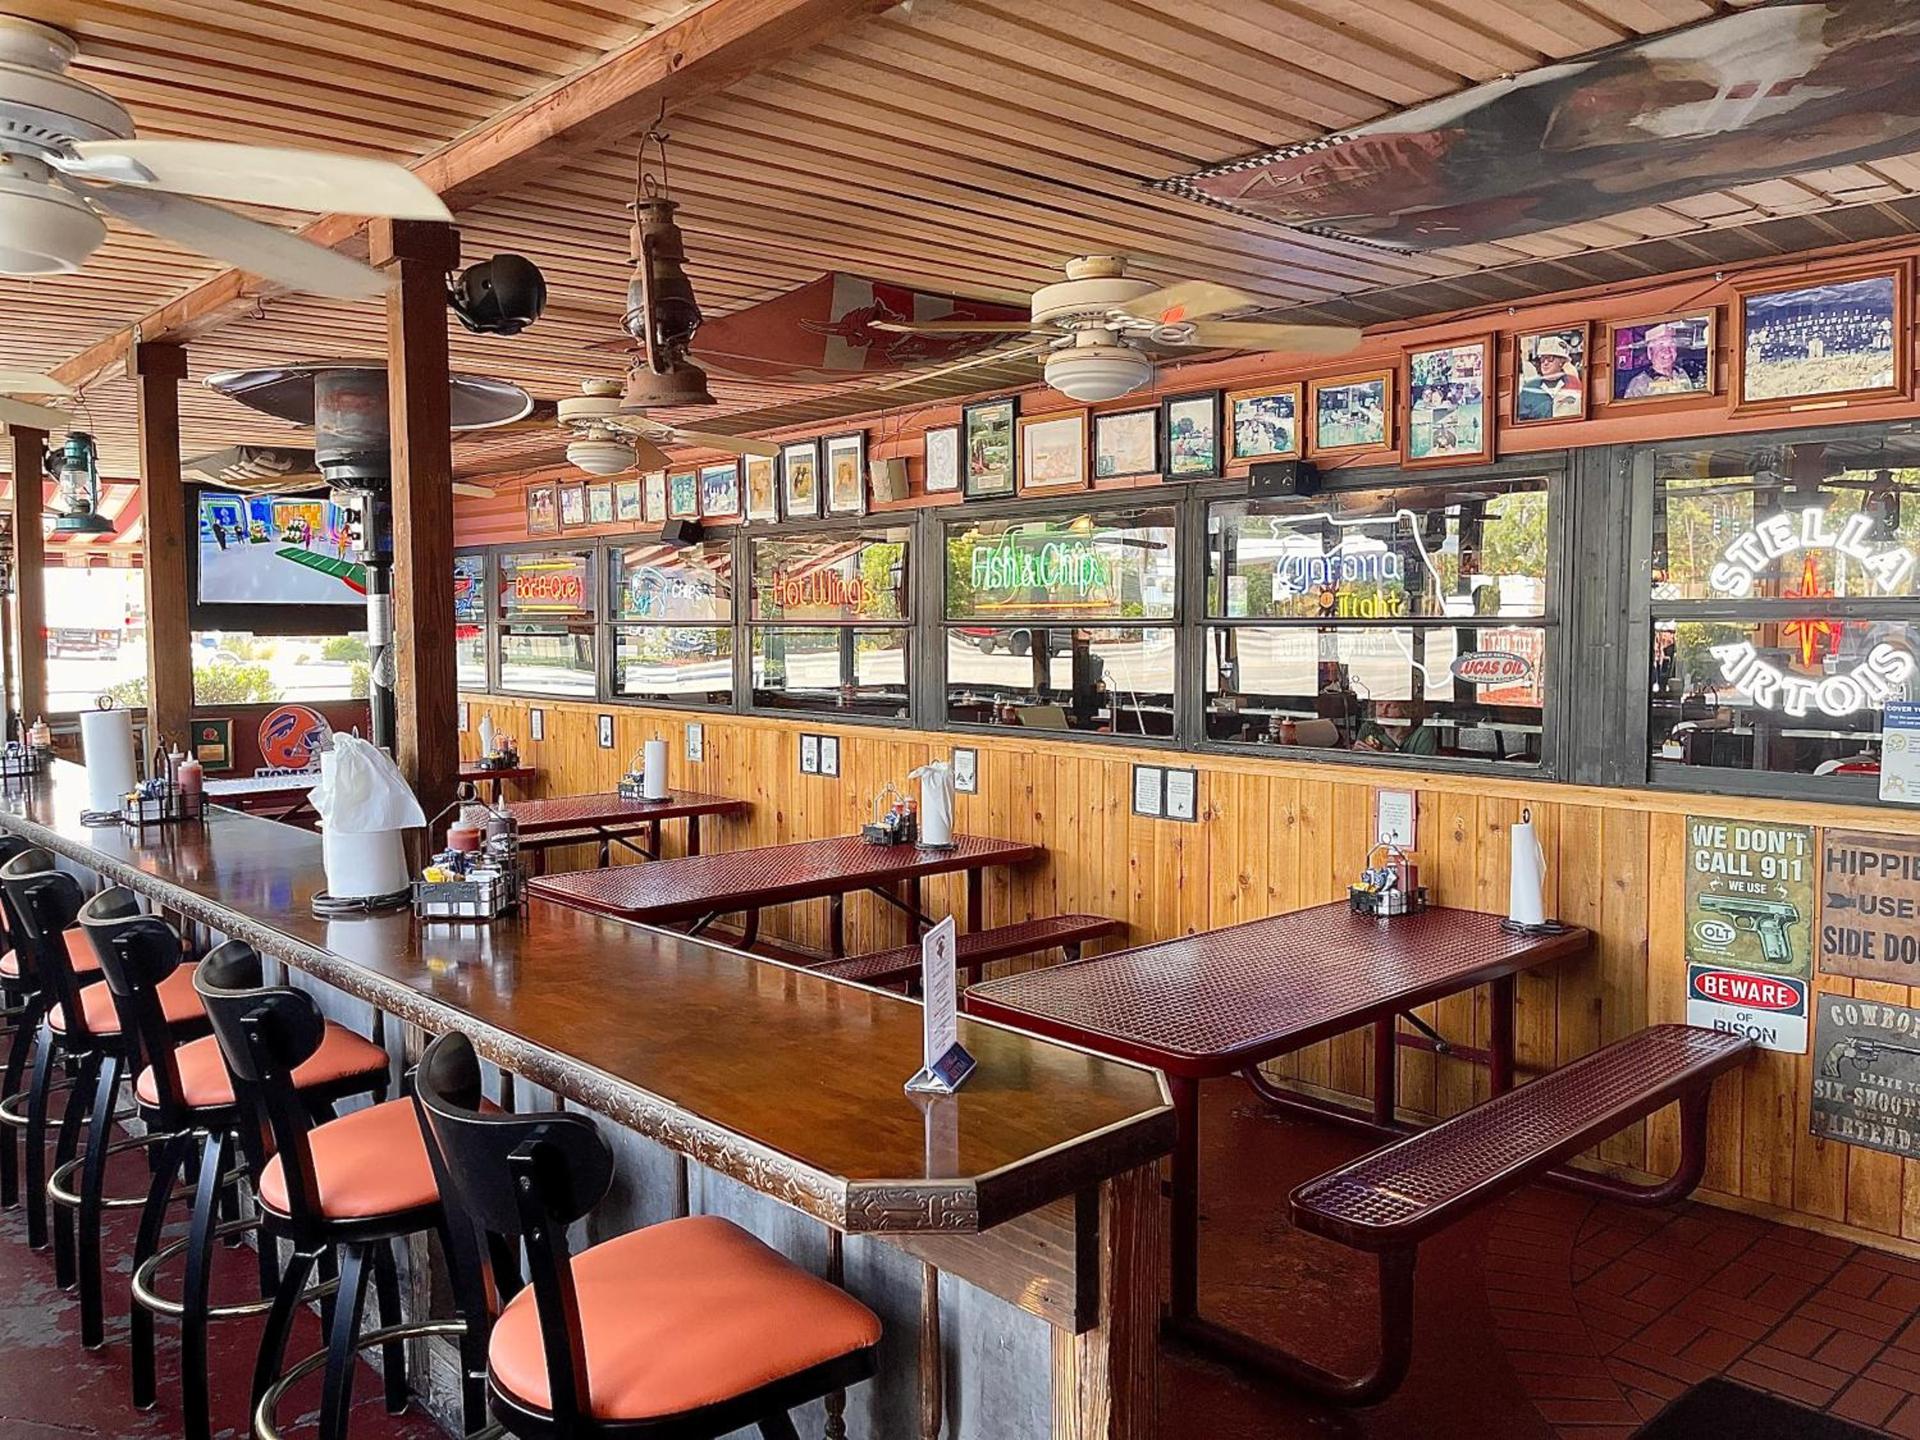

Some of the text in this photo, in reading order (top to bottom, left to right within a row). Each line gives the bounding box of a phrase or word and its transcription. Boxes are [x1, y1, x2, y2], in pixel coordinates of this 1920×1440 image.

[1710, 507, 1915, 597] STELLA
[971, 546, 1017, 589] Fish
[1040, 541, 1107, 597] Chips
[1277, 551, 1401, 595] Corona
[515, 575, 579, 600] Bar-B-Que
[773, 569, 873, 614] Hot Wings
[1502, 661, 1524, 675] OIL
[1709, 640, 1915, 717] ARTOIS
[1692, 824, 1806, 856] WE DON'T
[1695, 850, 1802, 882] CALL 911
[1728, 880, 1767, 894] WE USE
[1860, 894, 1914, 919] USE
[1823, 925, 1920, 964] SIDE DO
[1704, 975, 1788, 1006] BEWARE
[1714, 1018, 1777, 1044] BISON
[1736, 1012, 1753, 1022] OF
[1859, 1072, 1902, 1090] LEAVE
[1814, 1079, 1920, 1120] SIX-SHOOT
